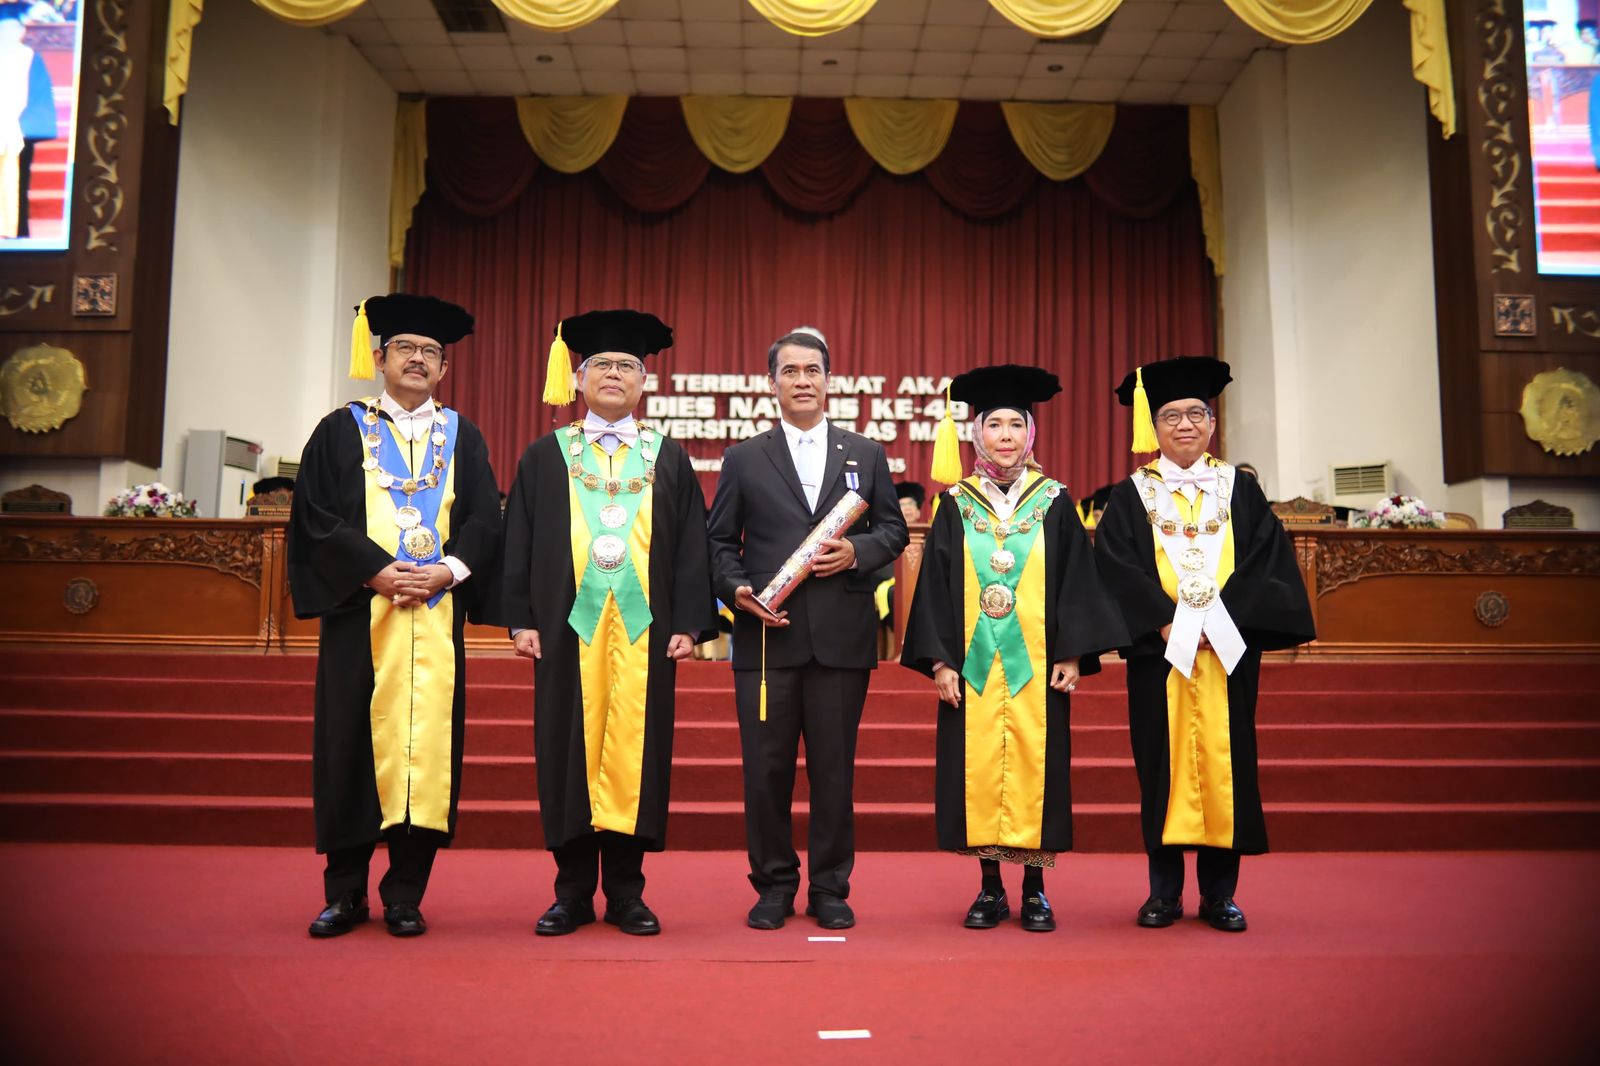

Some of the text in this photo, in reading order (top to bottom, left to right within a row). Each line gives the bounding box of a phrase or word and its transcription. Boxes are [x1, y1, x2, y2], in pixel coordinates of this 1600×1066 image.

[671, 374, 771, 393] TERBUK
[827, 375, 886, 394] ENAT
[646, 396, 969, 421] DIES NATIS KE-49
